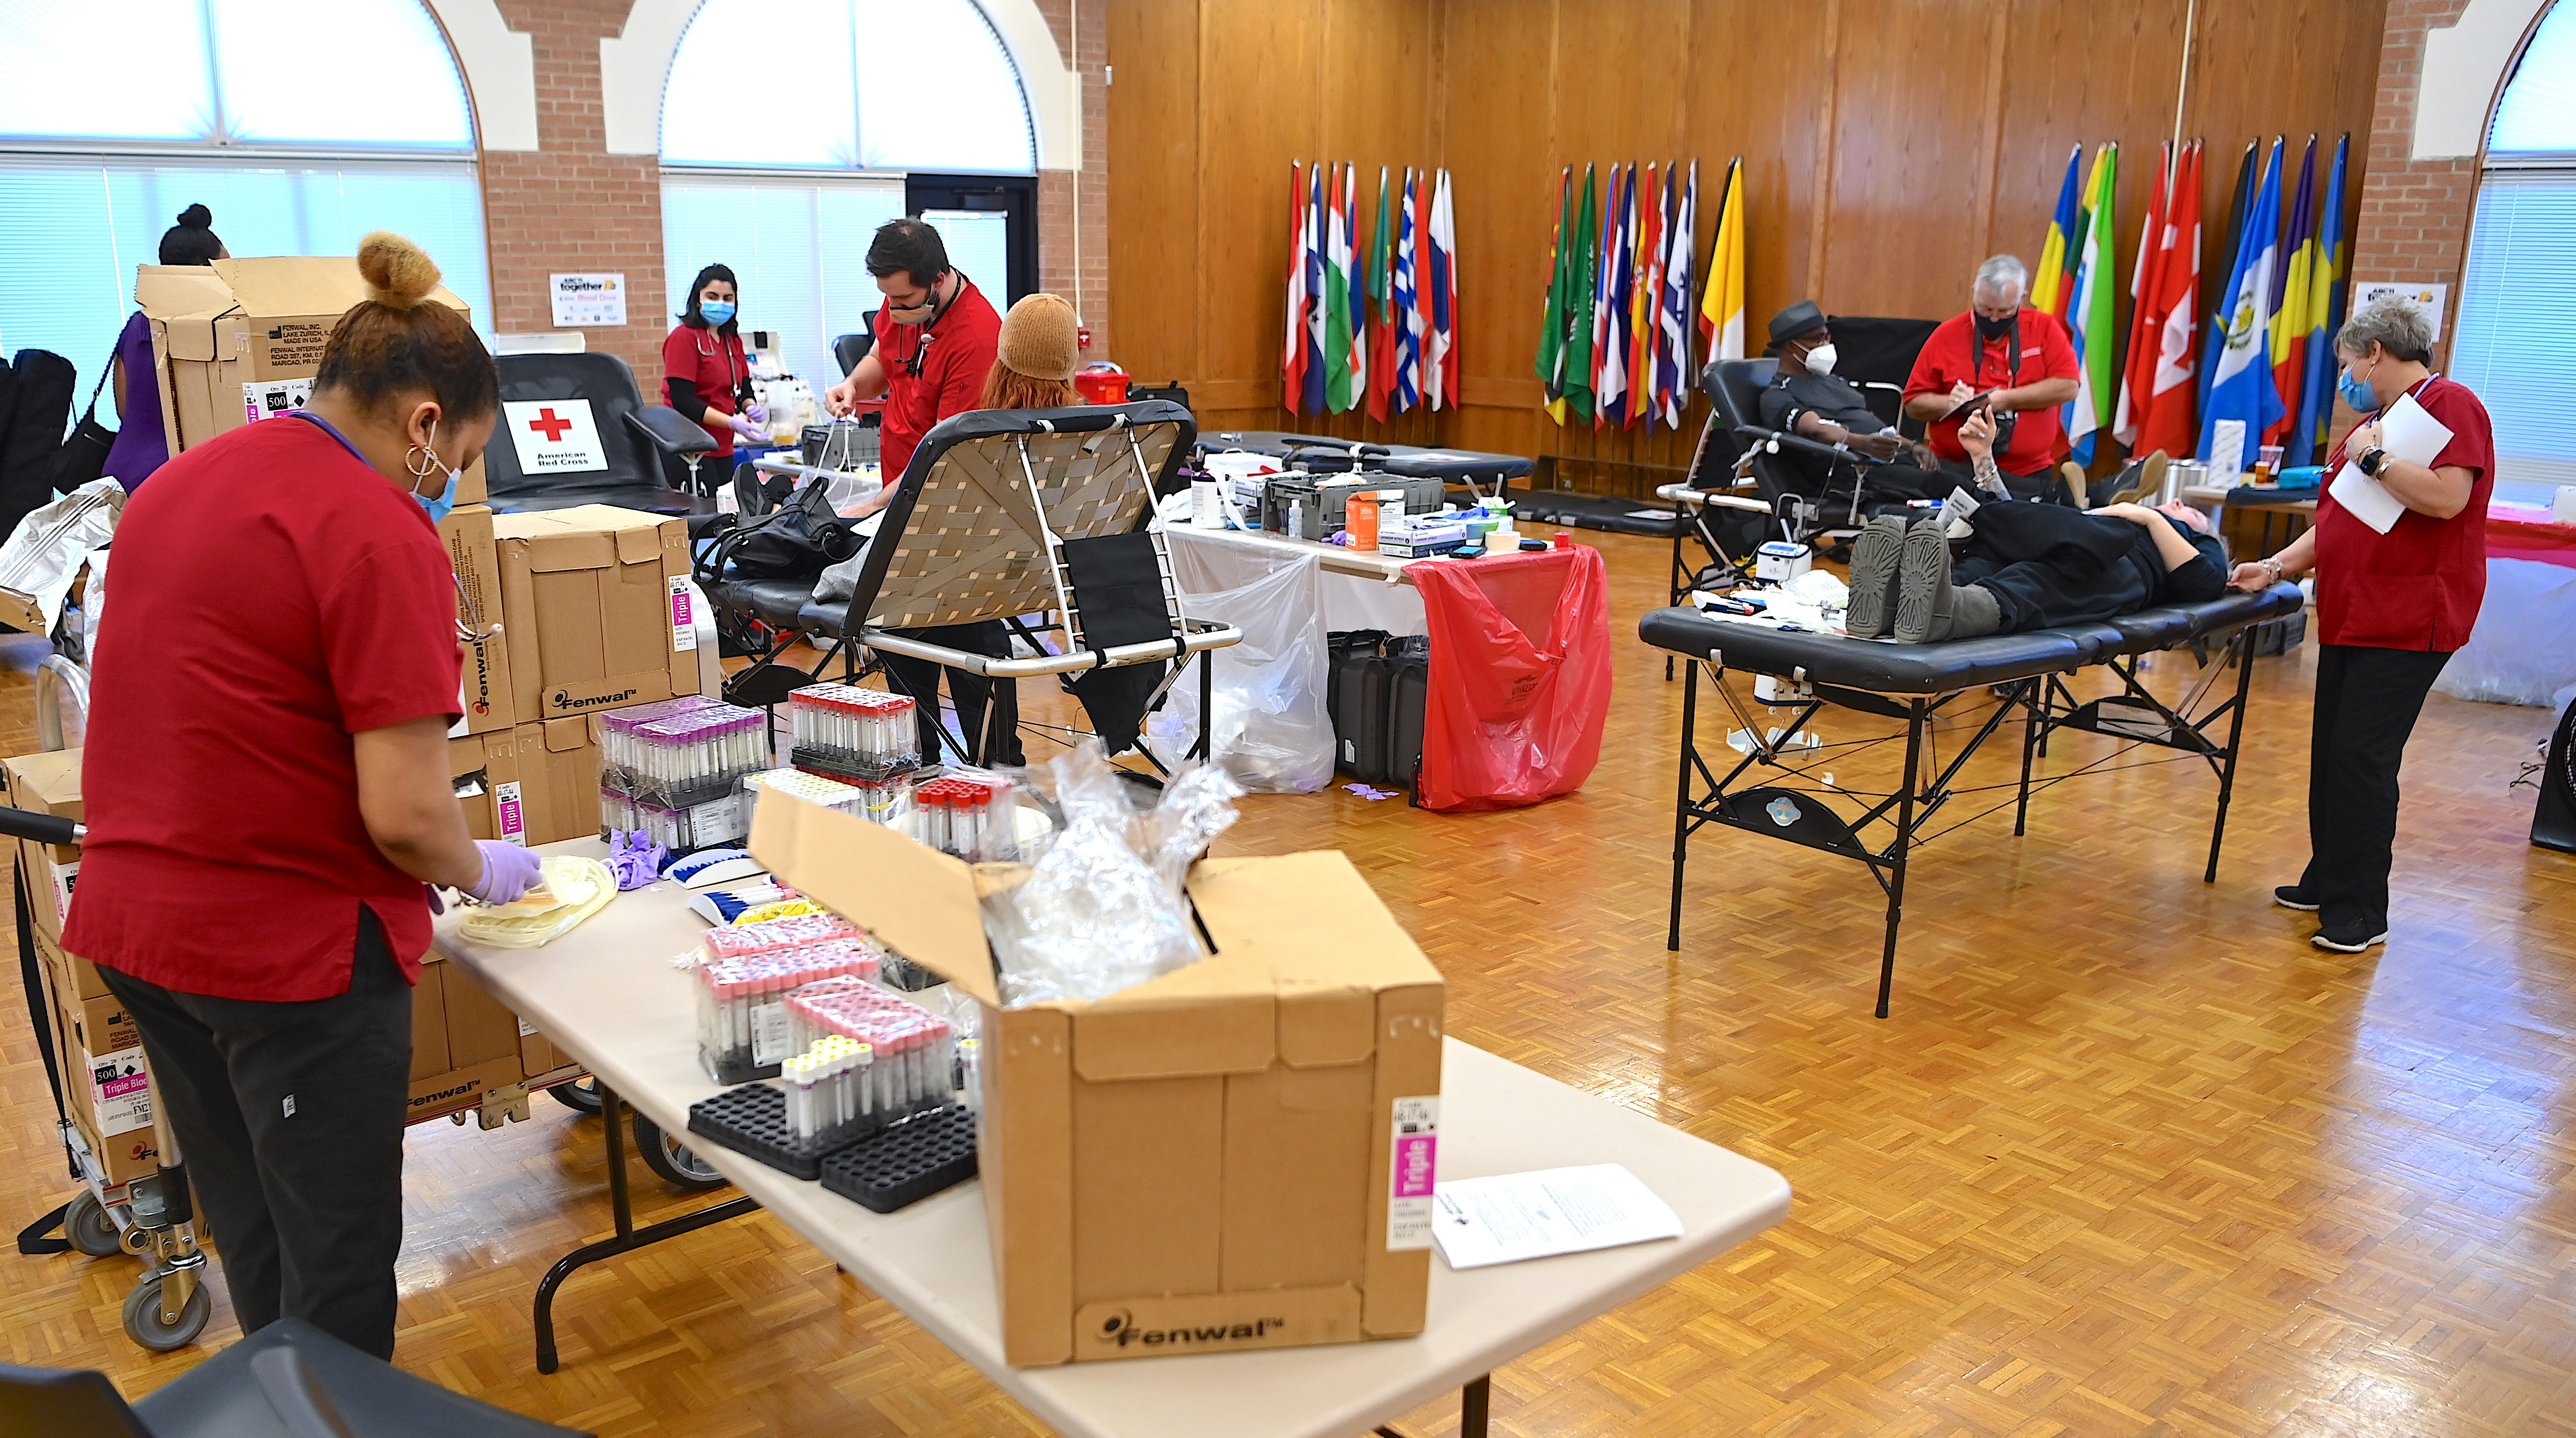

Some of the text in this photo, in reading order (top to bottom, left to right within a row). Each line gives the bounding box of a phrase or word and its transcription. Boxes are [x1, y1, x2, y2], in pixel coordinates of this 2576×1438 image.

[560, 283, 602, 293] together
[269, 396, 286, 407] 500
[538, 452, 586, 460] American
[676, 596, 688, 623] Triple
[473, 642, 489, 707] Fenwal
[505, 804, 519, 832] Triple
[110, 1028, 137, 1038] FENWAL
[111, 1035, 129, 1044] ROAD
[97, 1069, 116, 1081] 500
[105, 1081, 130, 1095] Triple
[1402, 1139, 1430, 1196] Triple
